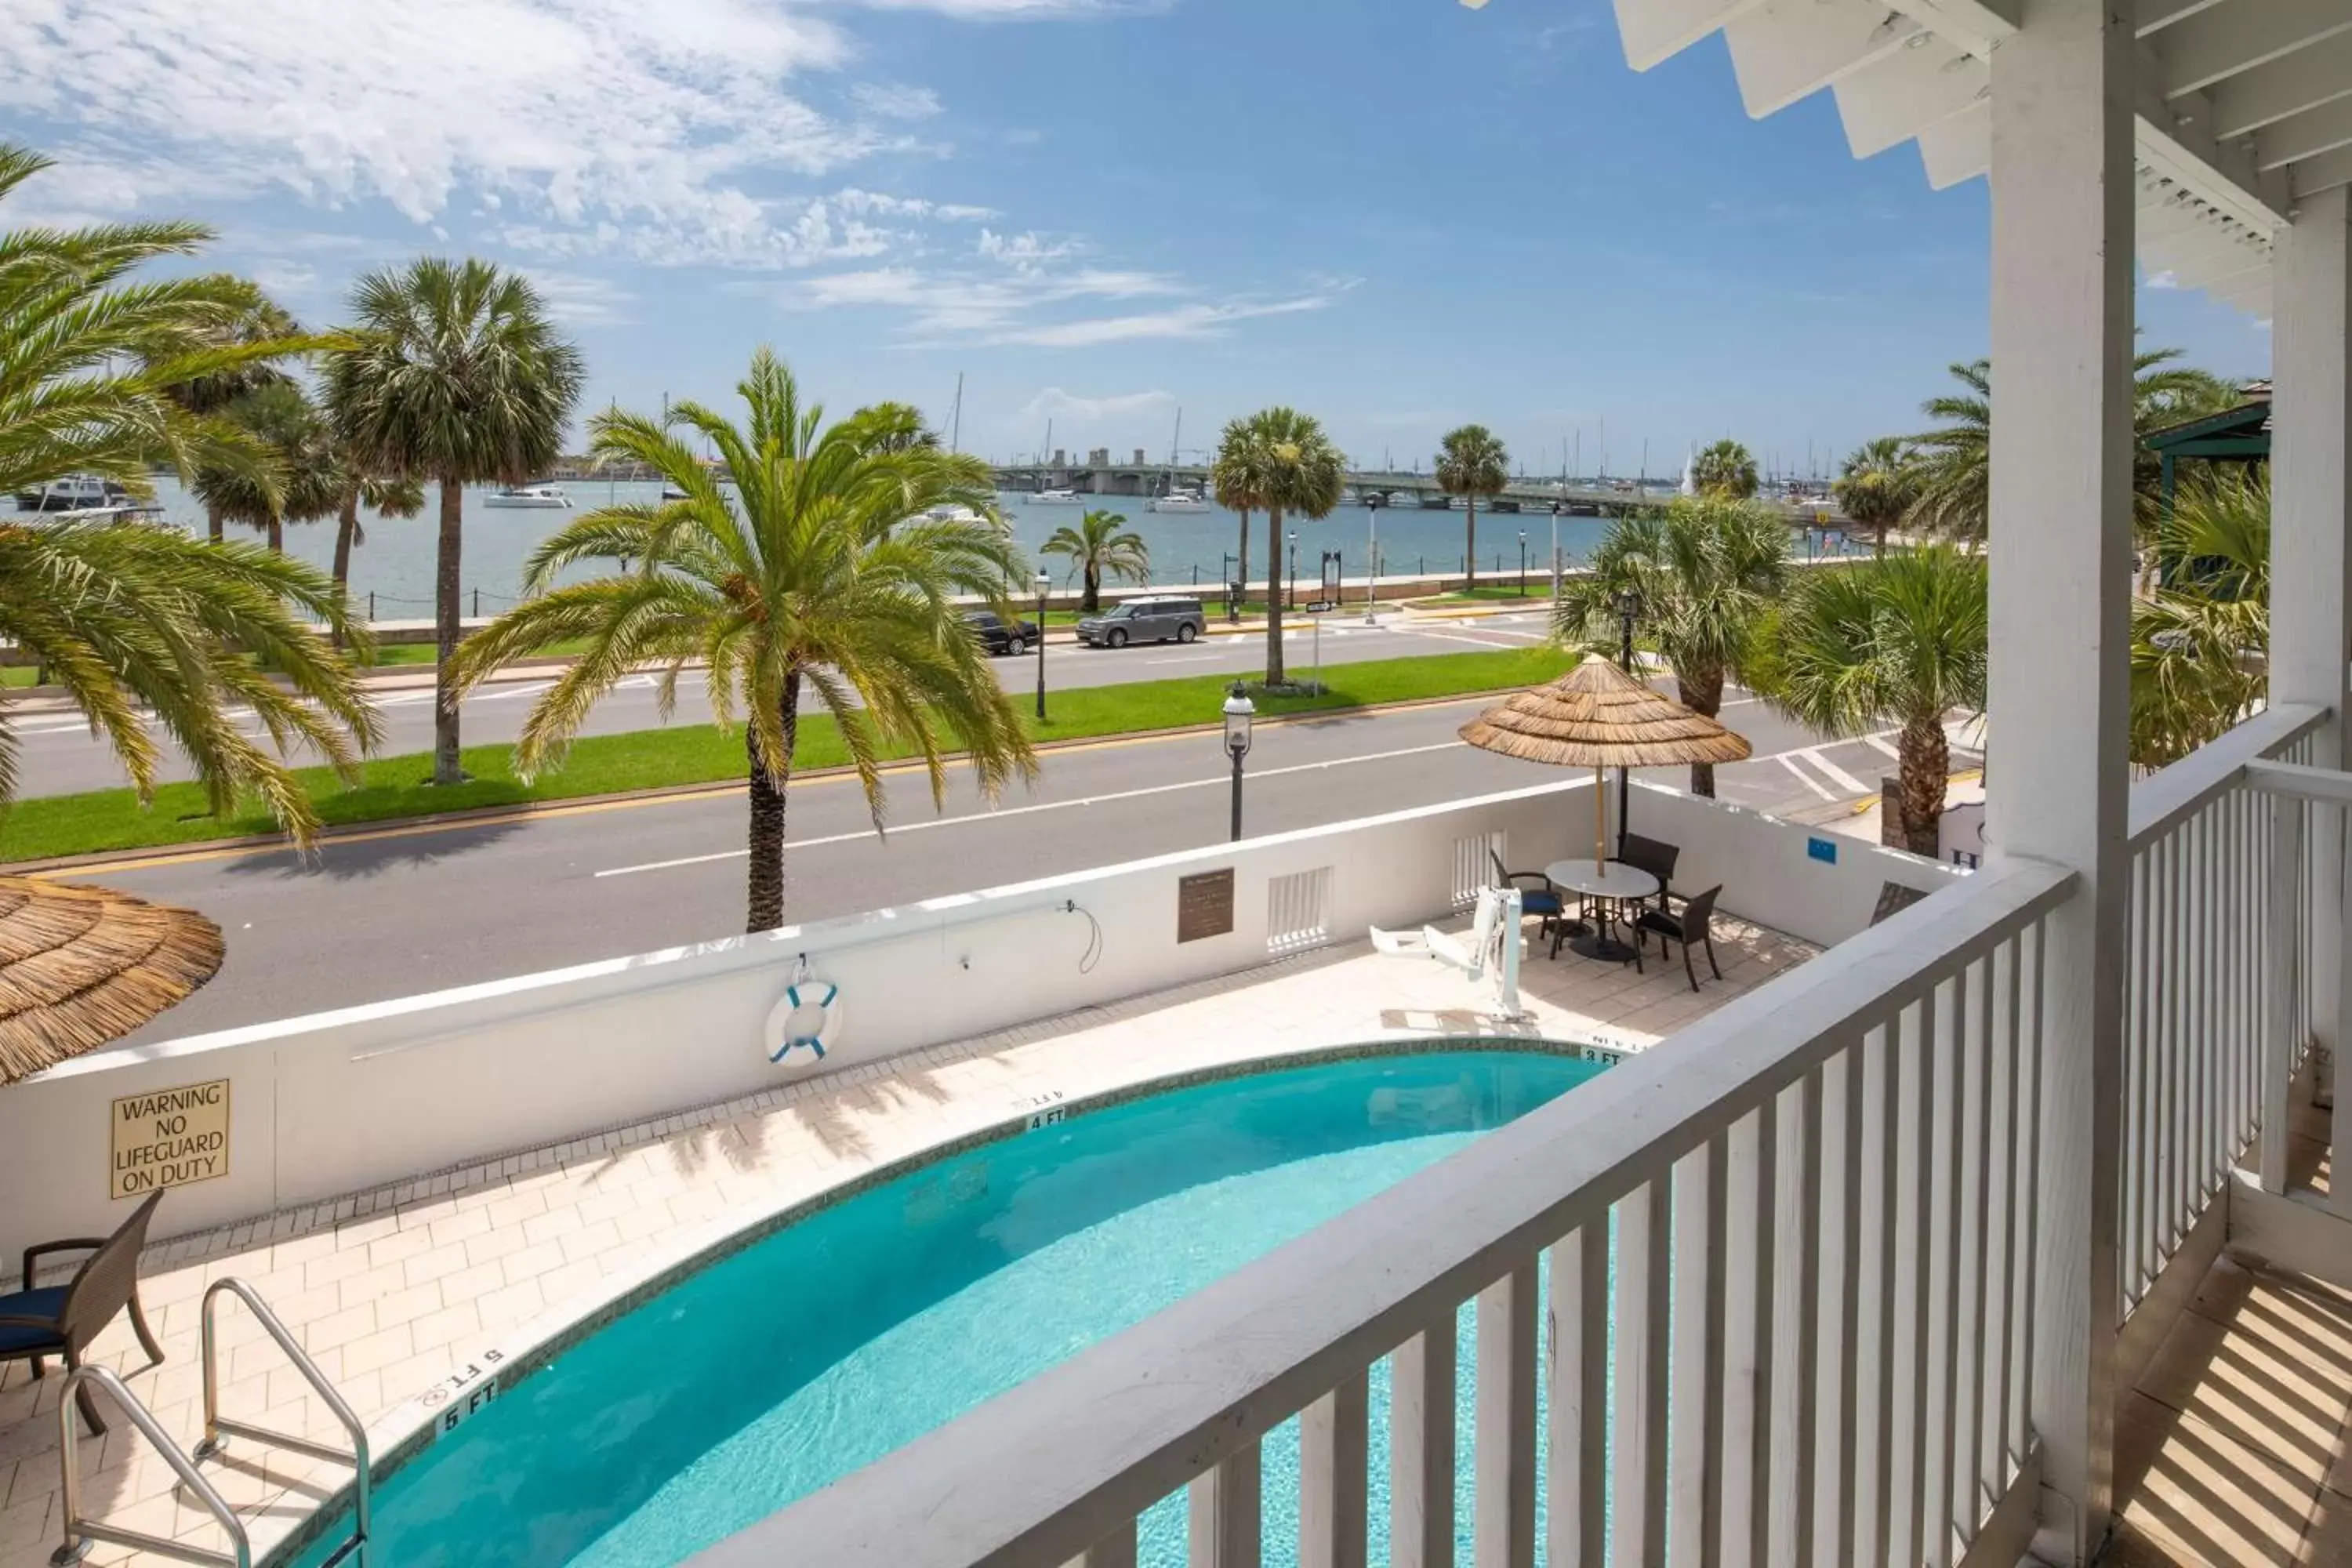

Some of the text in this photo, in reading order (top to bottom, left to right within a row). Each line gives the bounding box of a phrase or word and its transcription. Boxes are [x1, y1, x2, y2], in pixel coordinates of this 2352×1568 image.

[1586, 1049, 1621, 1065] 3 FT
[122, 1085, 220, 1121] WARNING
[1031, 1109, 1064, 1130] 4 FT
[156, 1116, 187, 1139] NO
[116, 1131, 223, 1171] LIFEGUARD
[123, 1155, 216, 1192] ON DUTY
[451, 1348, 504, 1388] 5 FT
[445, 1381, 495, 1432] 5 FT
